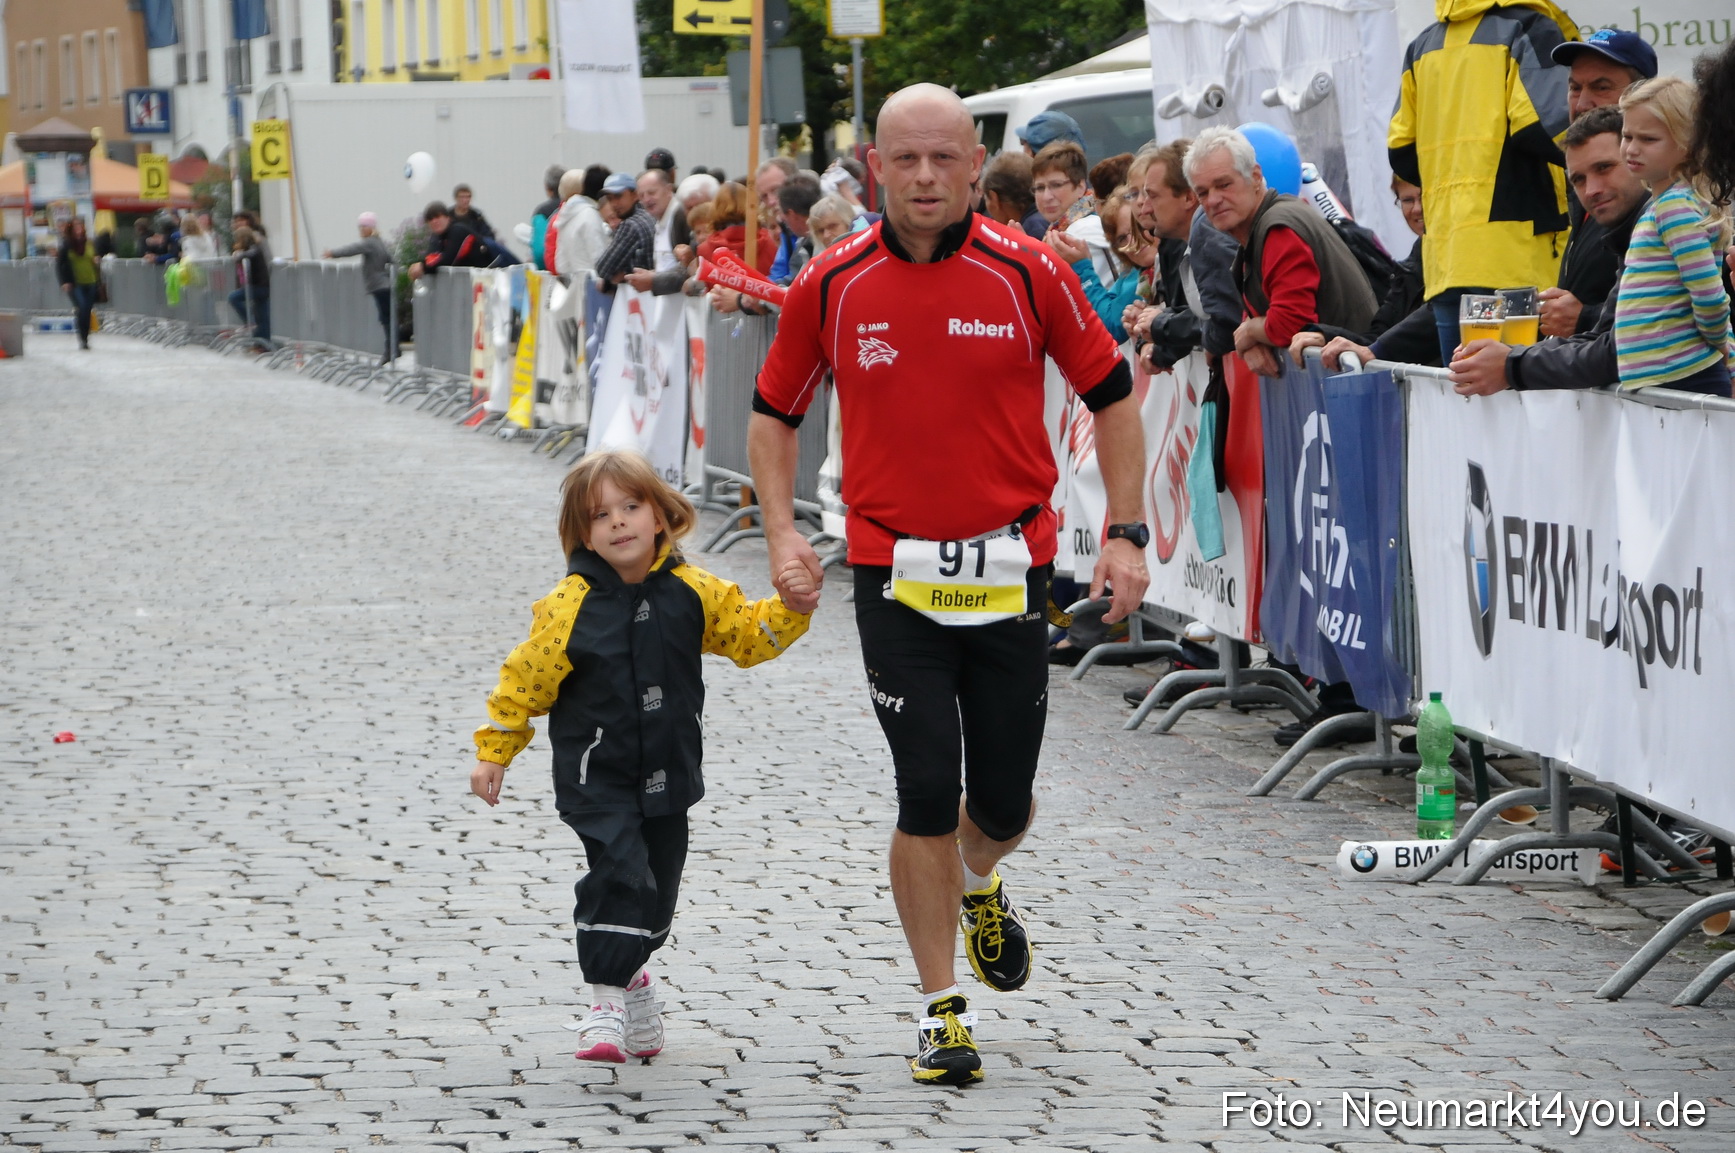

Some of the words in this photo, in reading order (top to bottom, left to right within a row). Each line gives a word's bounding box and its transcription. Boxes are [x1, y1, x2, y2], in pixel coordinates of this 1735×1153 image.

[254, 122, 285, 133] Block
[261, 137, 281, 166] C
[146, 167, 162, 189] D
[708, 268, 742, 287] Audi
[744, 279, 772, 298] BKK
[868, 322, 889, 331] JAKO
[948, 318, 1014, 338] Robert
[939, 540, 986, 578] 91
[931, 589, 988, 607] Robert
[868, 681, 905, 713] bert
